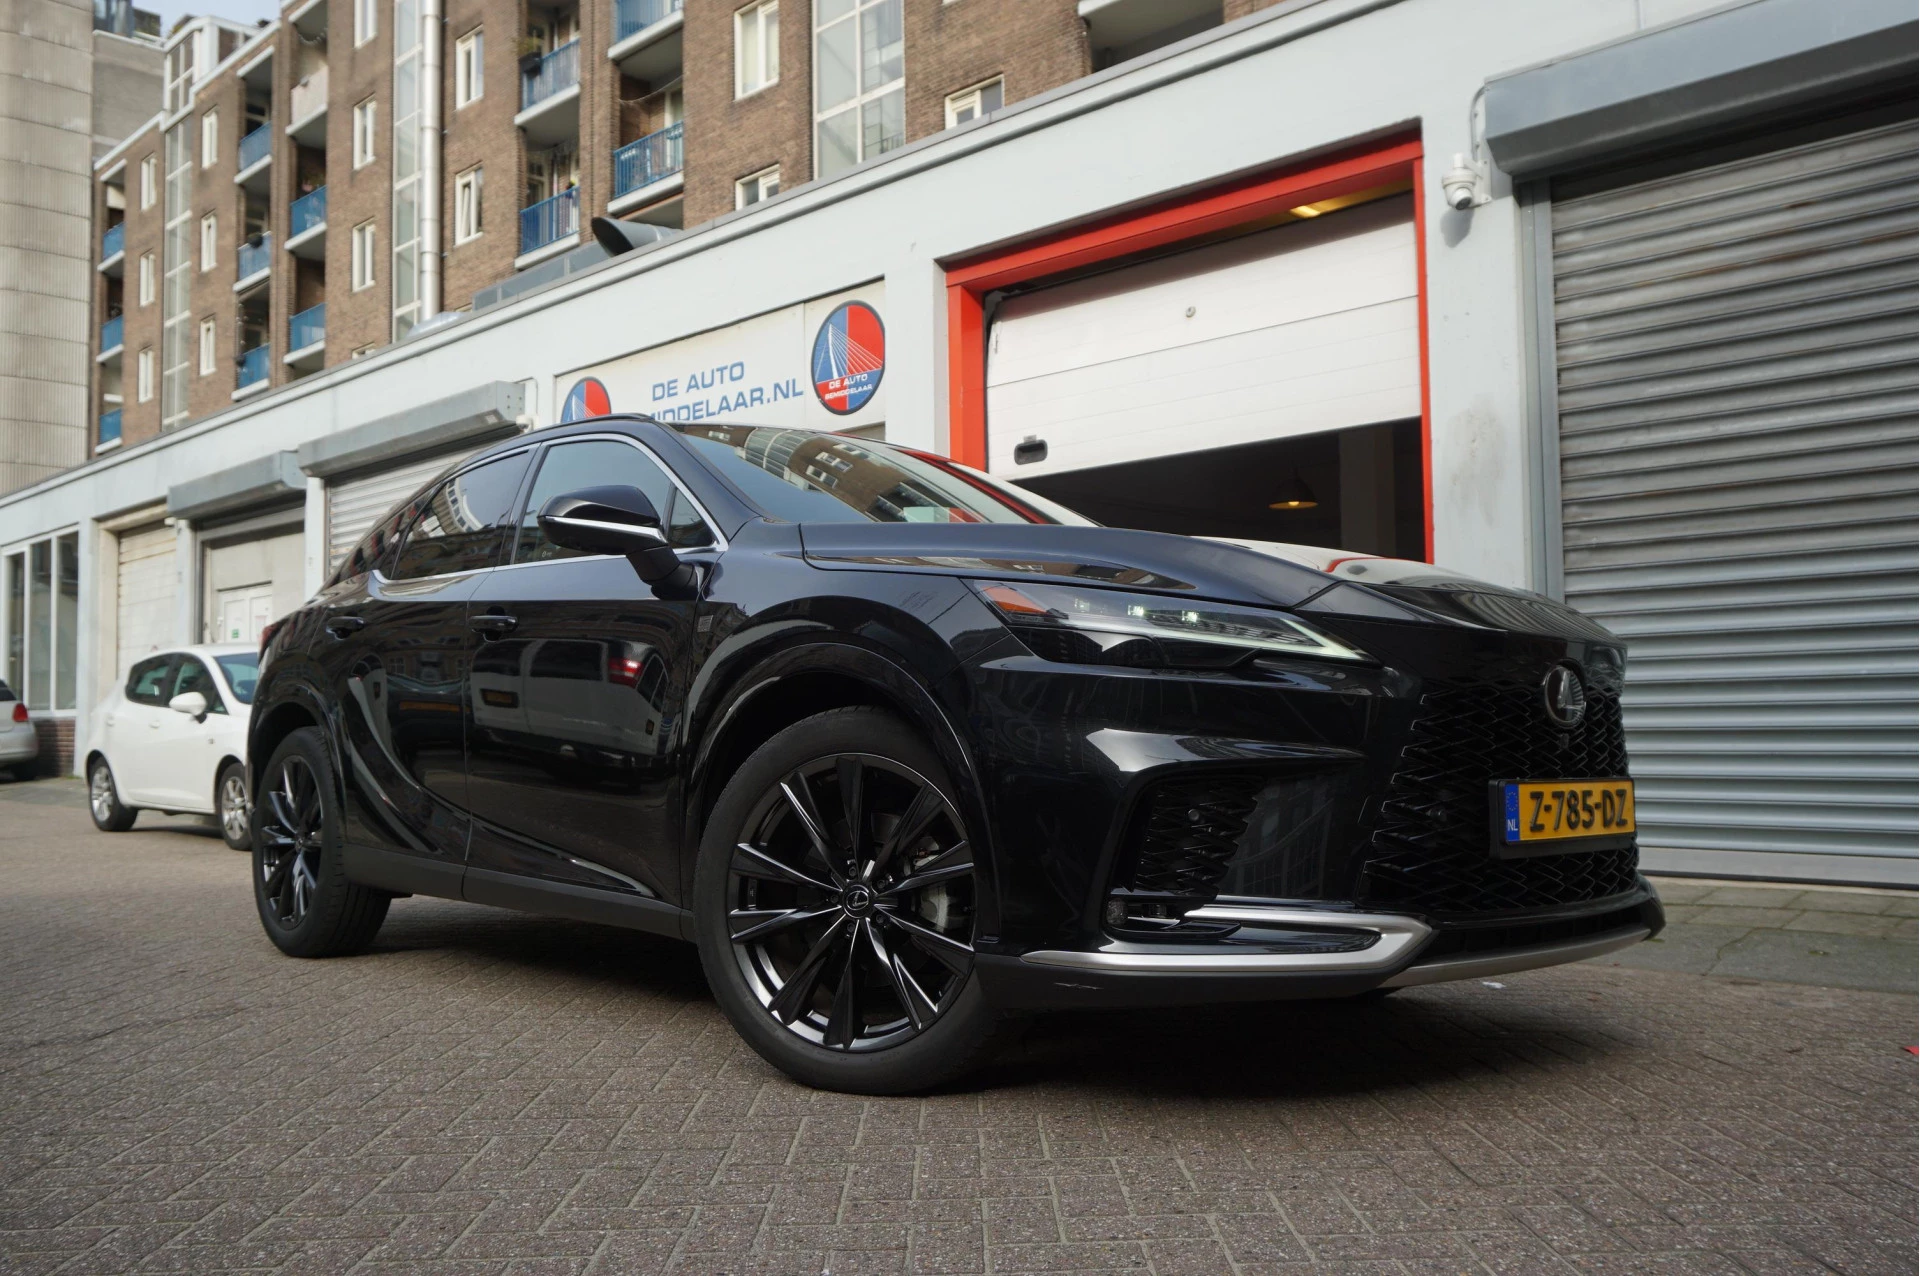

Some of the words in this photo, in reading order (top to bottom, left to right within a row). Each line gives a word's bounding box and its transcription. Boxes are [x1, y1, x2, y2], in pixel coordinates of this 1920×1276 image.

[652, 378, 679, 402] DE
[686, 361, 745, 393] AUTO
[829, 380, 841, 390] DE
[843, 374, 868, 386] AUTO
[1530, 789, 1627, 832] Z-785-DZ
[1507, 819, 1518, 831] NL
